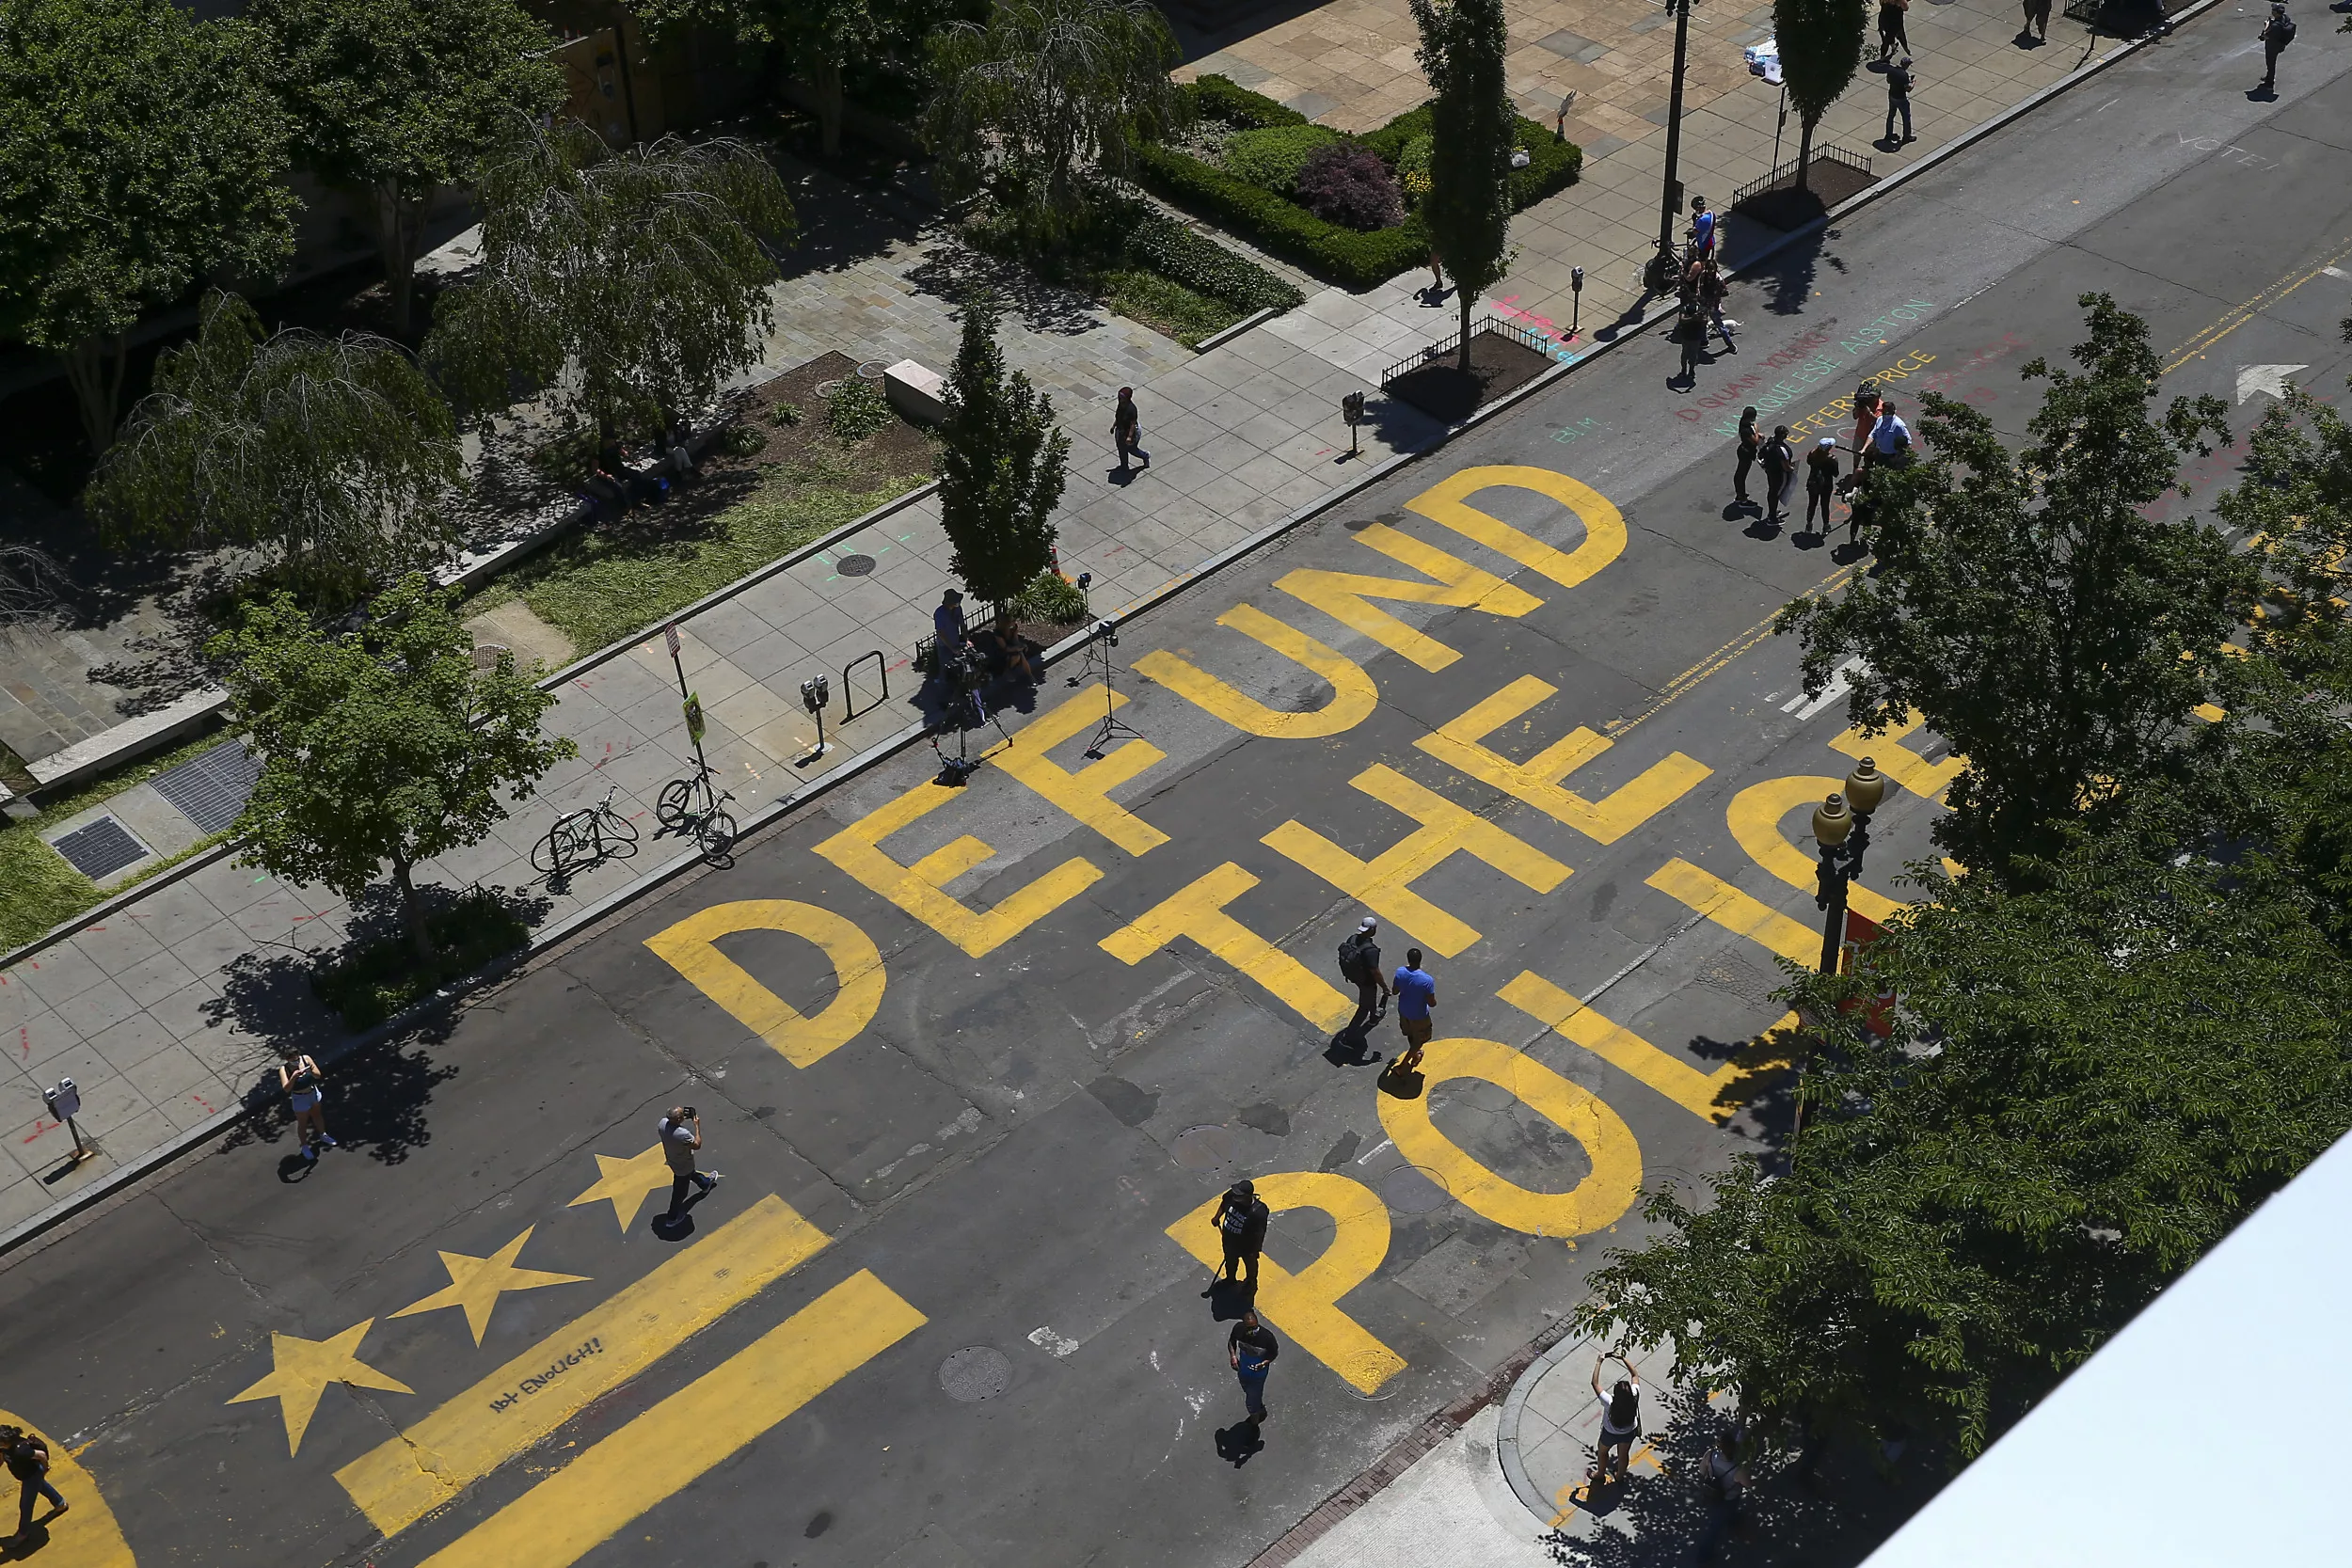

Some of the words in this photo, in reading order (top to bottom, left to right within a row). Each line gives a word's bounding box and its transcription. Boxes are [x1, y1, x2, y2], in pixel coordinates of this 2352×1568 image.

[1839, 297, 1934, 355] ALSTON
[1861, 349, 1937, 388] PRICE
[1549, 417, 1602, 444] BLM
[644, 464, 1629, 1069] DEFUND
[1098, 673, 1713, 1037] THE
